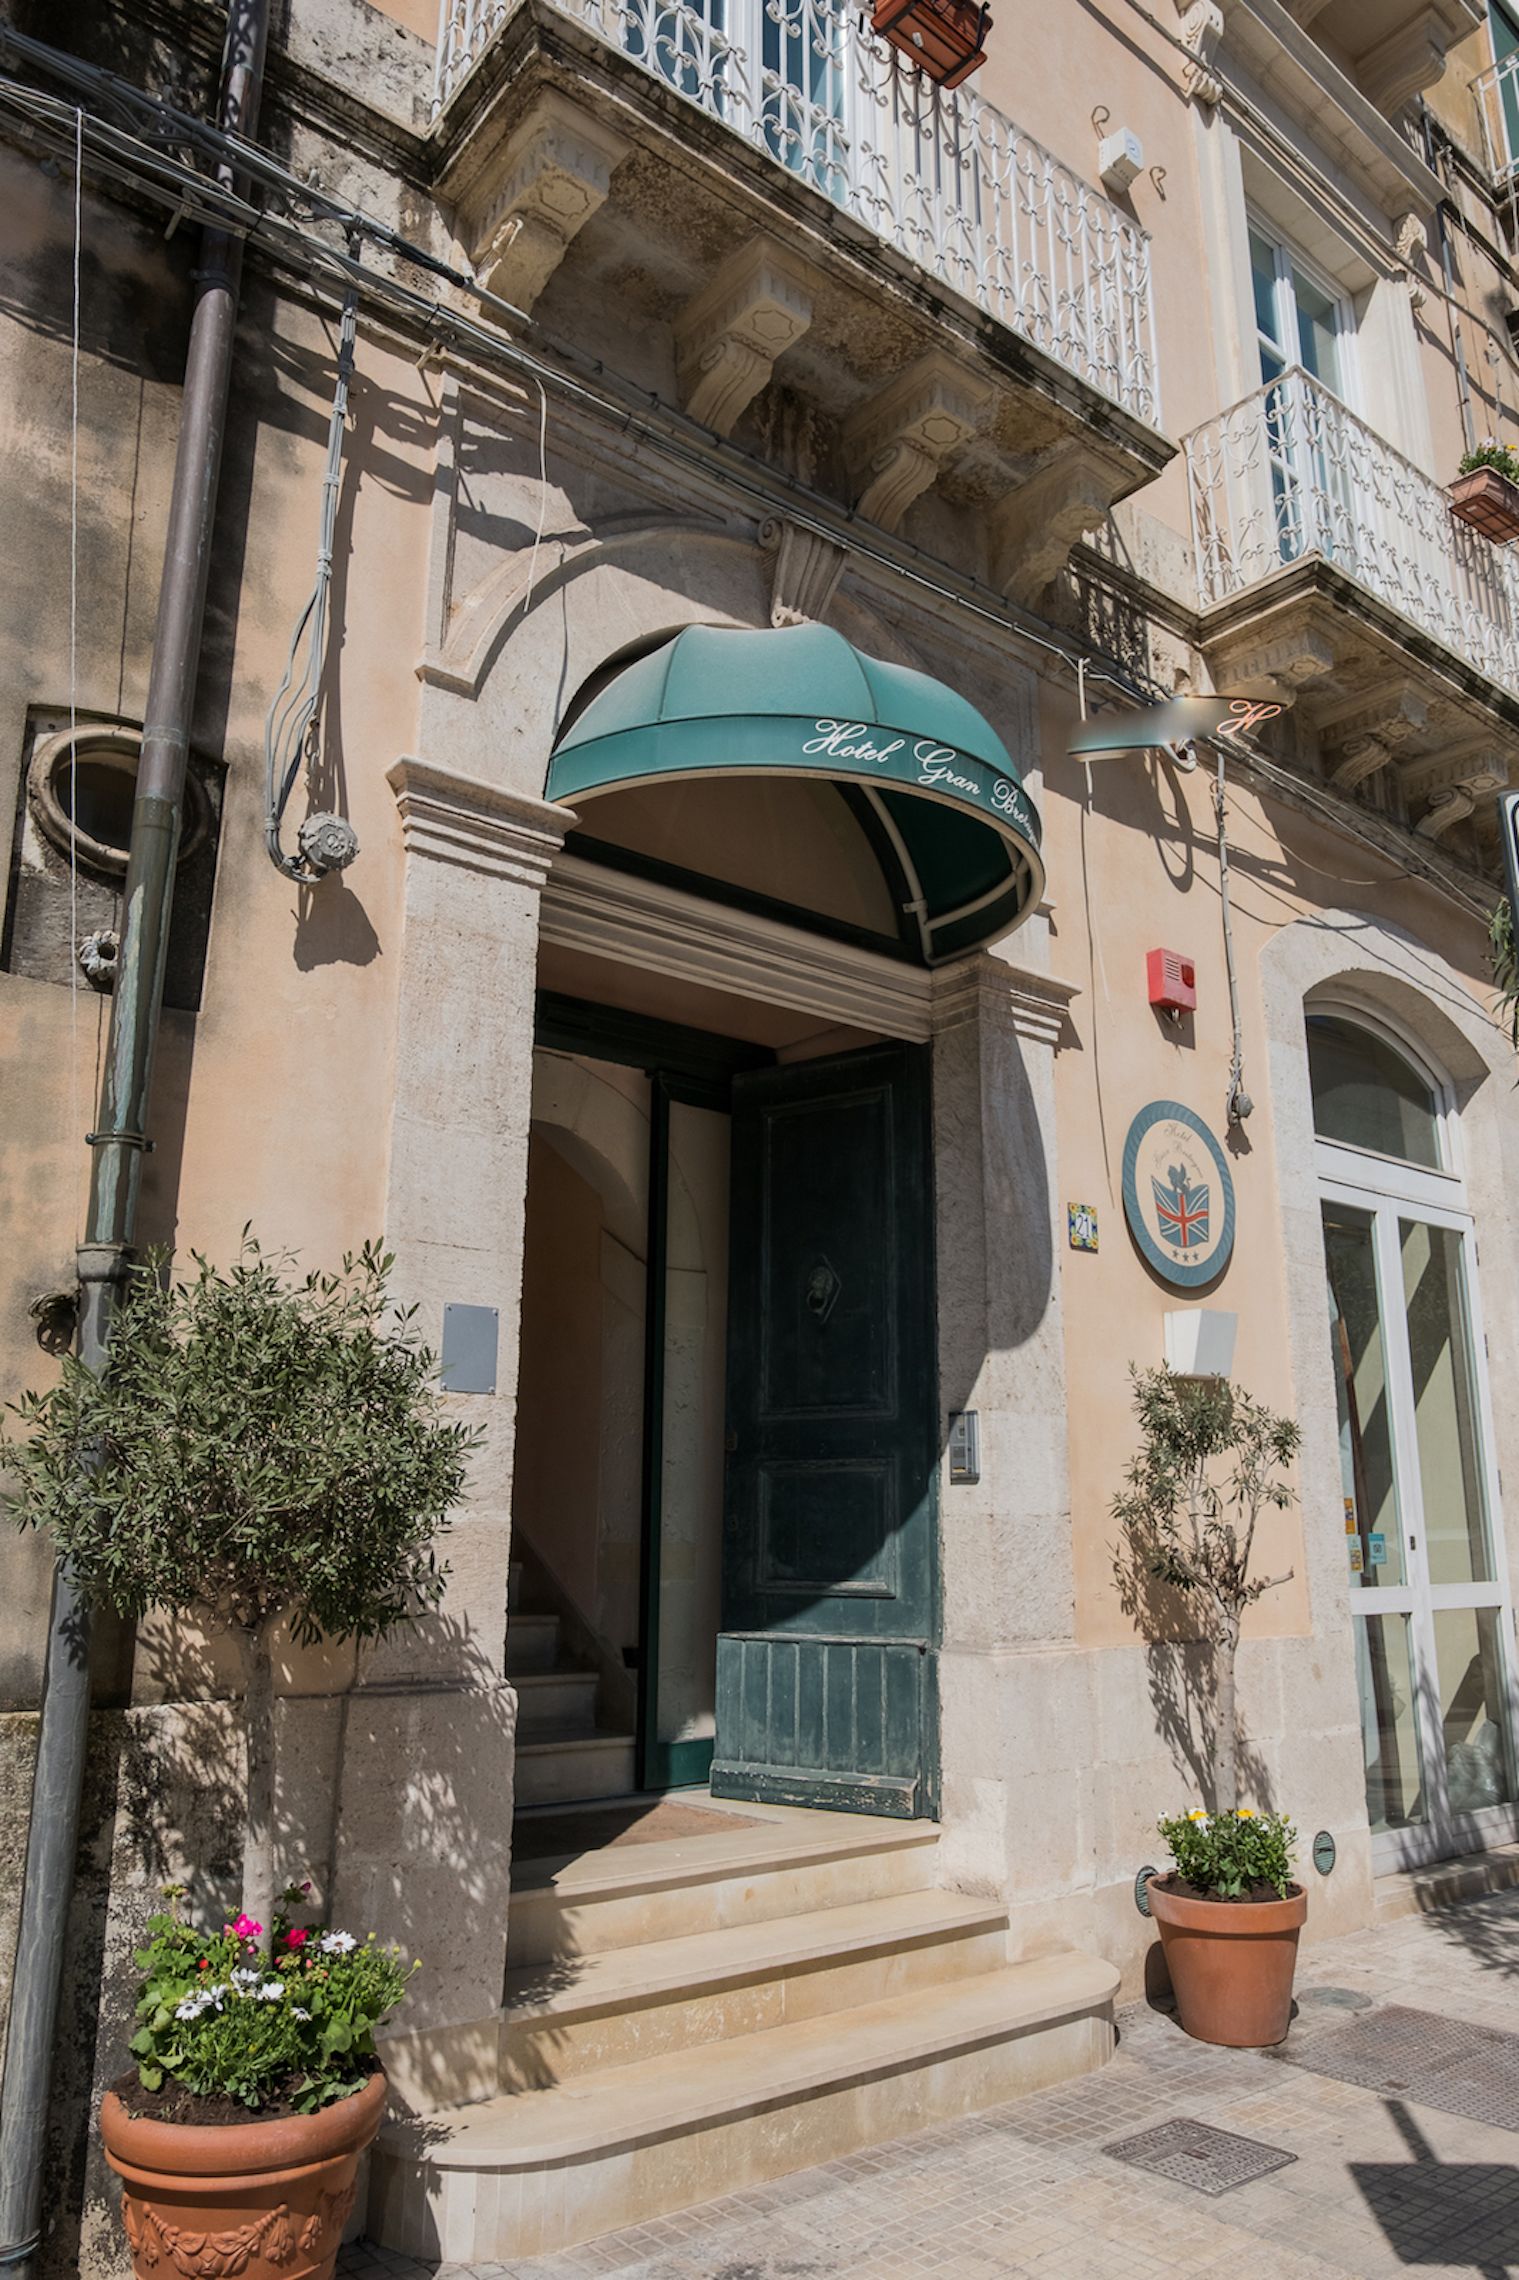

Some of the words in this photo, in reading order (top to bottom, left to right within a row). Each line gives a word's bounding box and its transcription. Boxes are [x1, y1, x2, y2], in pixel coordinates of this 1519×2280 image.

[802, 719, 906, 763] Hotel
[913, 740, 981, 796] Gran
[1076, 1213, 1090, 1238] 21
